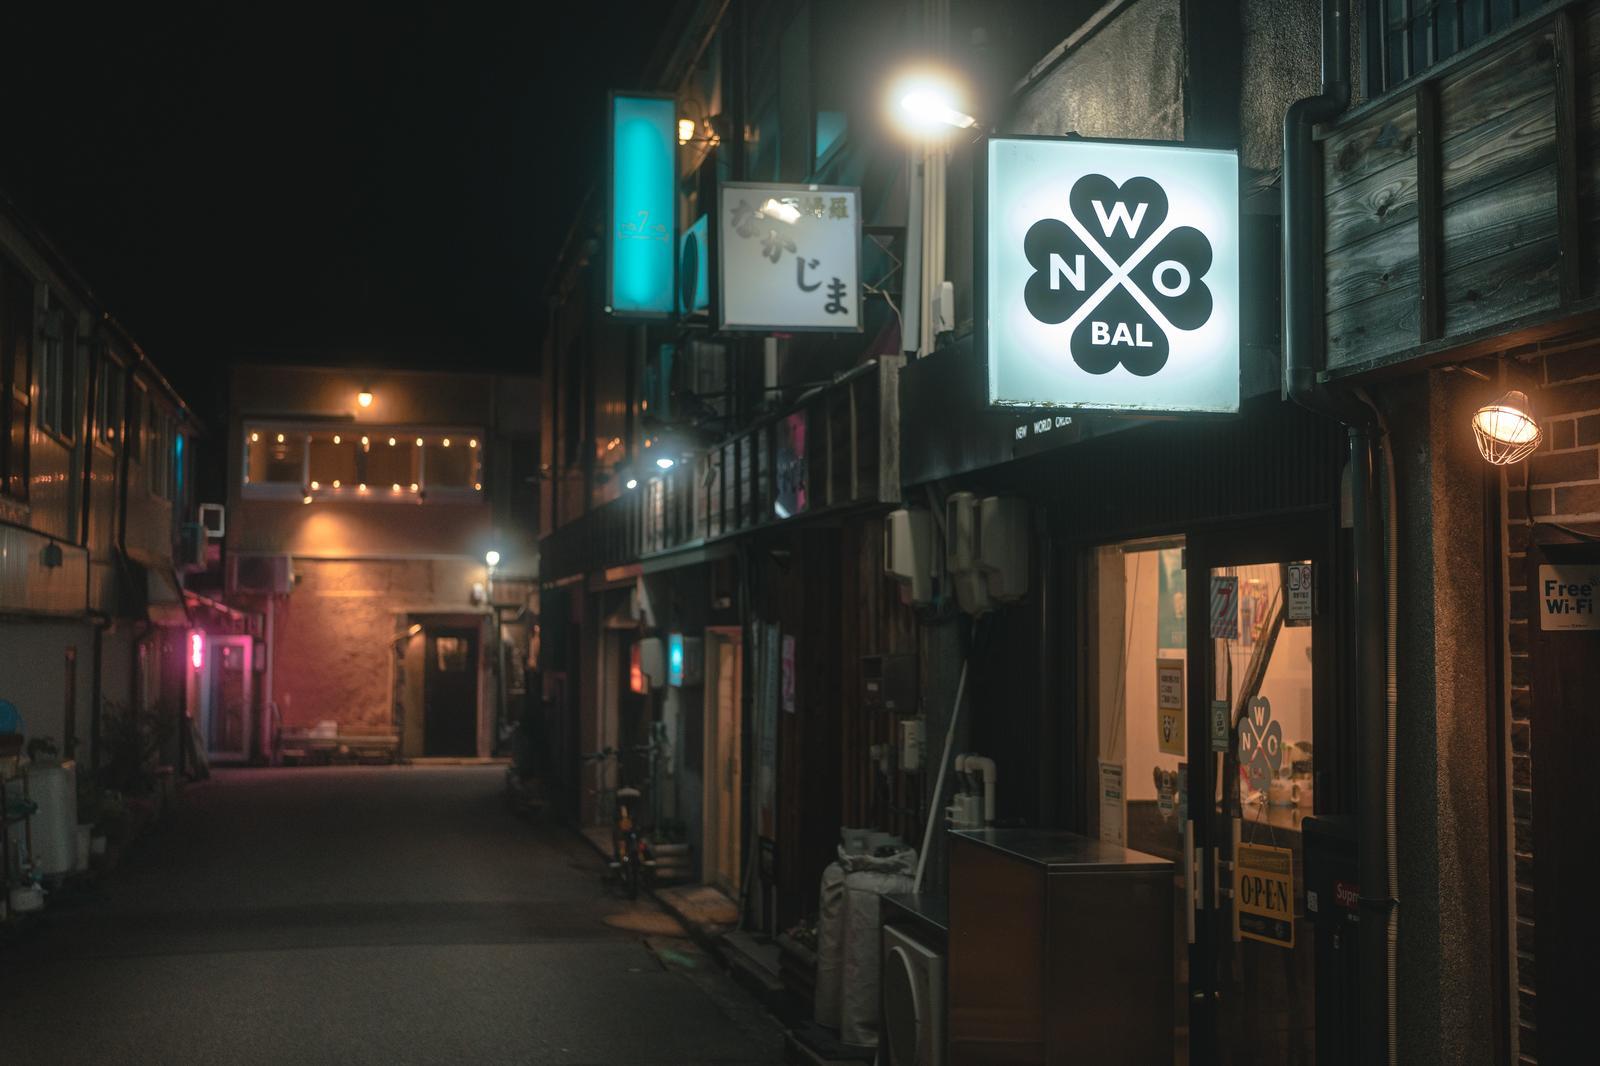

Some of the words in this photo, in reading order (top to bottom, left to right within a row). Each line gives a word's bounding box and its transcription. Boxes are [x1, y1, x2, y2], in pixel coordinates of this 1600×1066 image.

[1091, 200, 1149, 239] W
[1050, 253, 1085, 291] N
[1152, 260, 1190, 297] O
[1091, 321, 1153, 347] BAL
[1015, 425, 1028, 440] NEW
[1033, 418, 1052, 434] WORLD
[1545, 580, 1592, 596] Free
[1546, 599, 1592, 614] Wi-Fi
[1254, 706, 1265, 727] W
[1242, 732, 1251, 751] N
